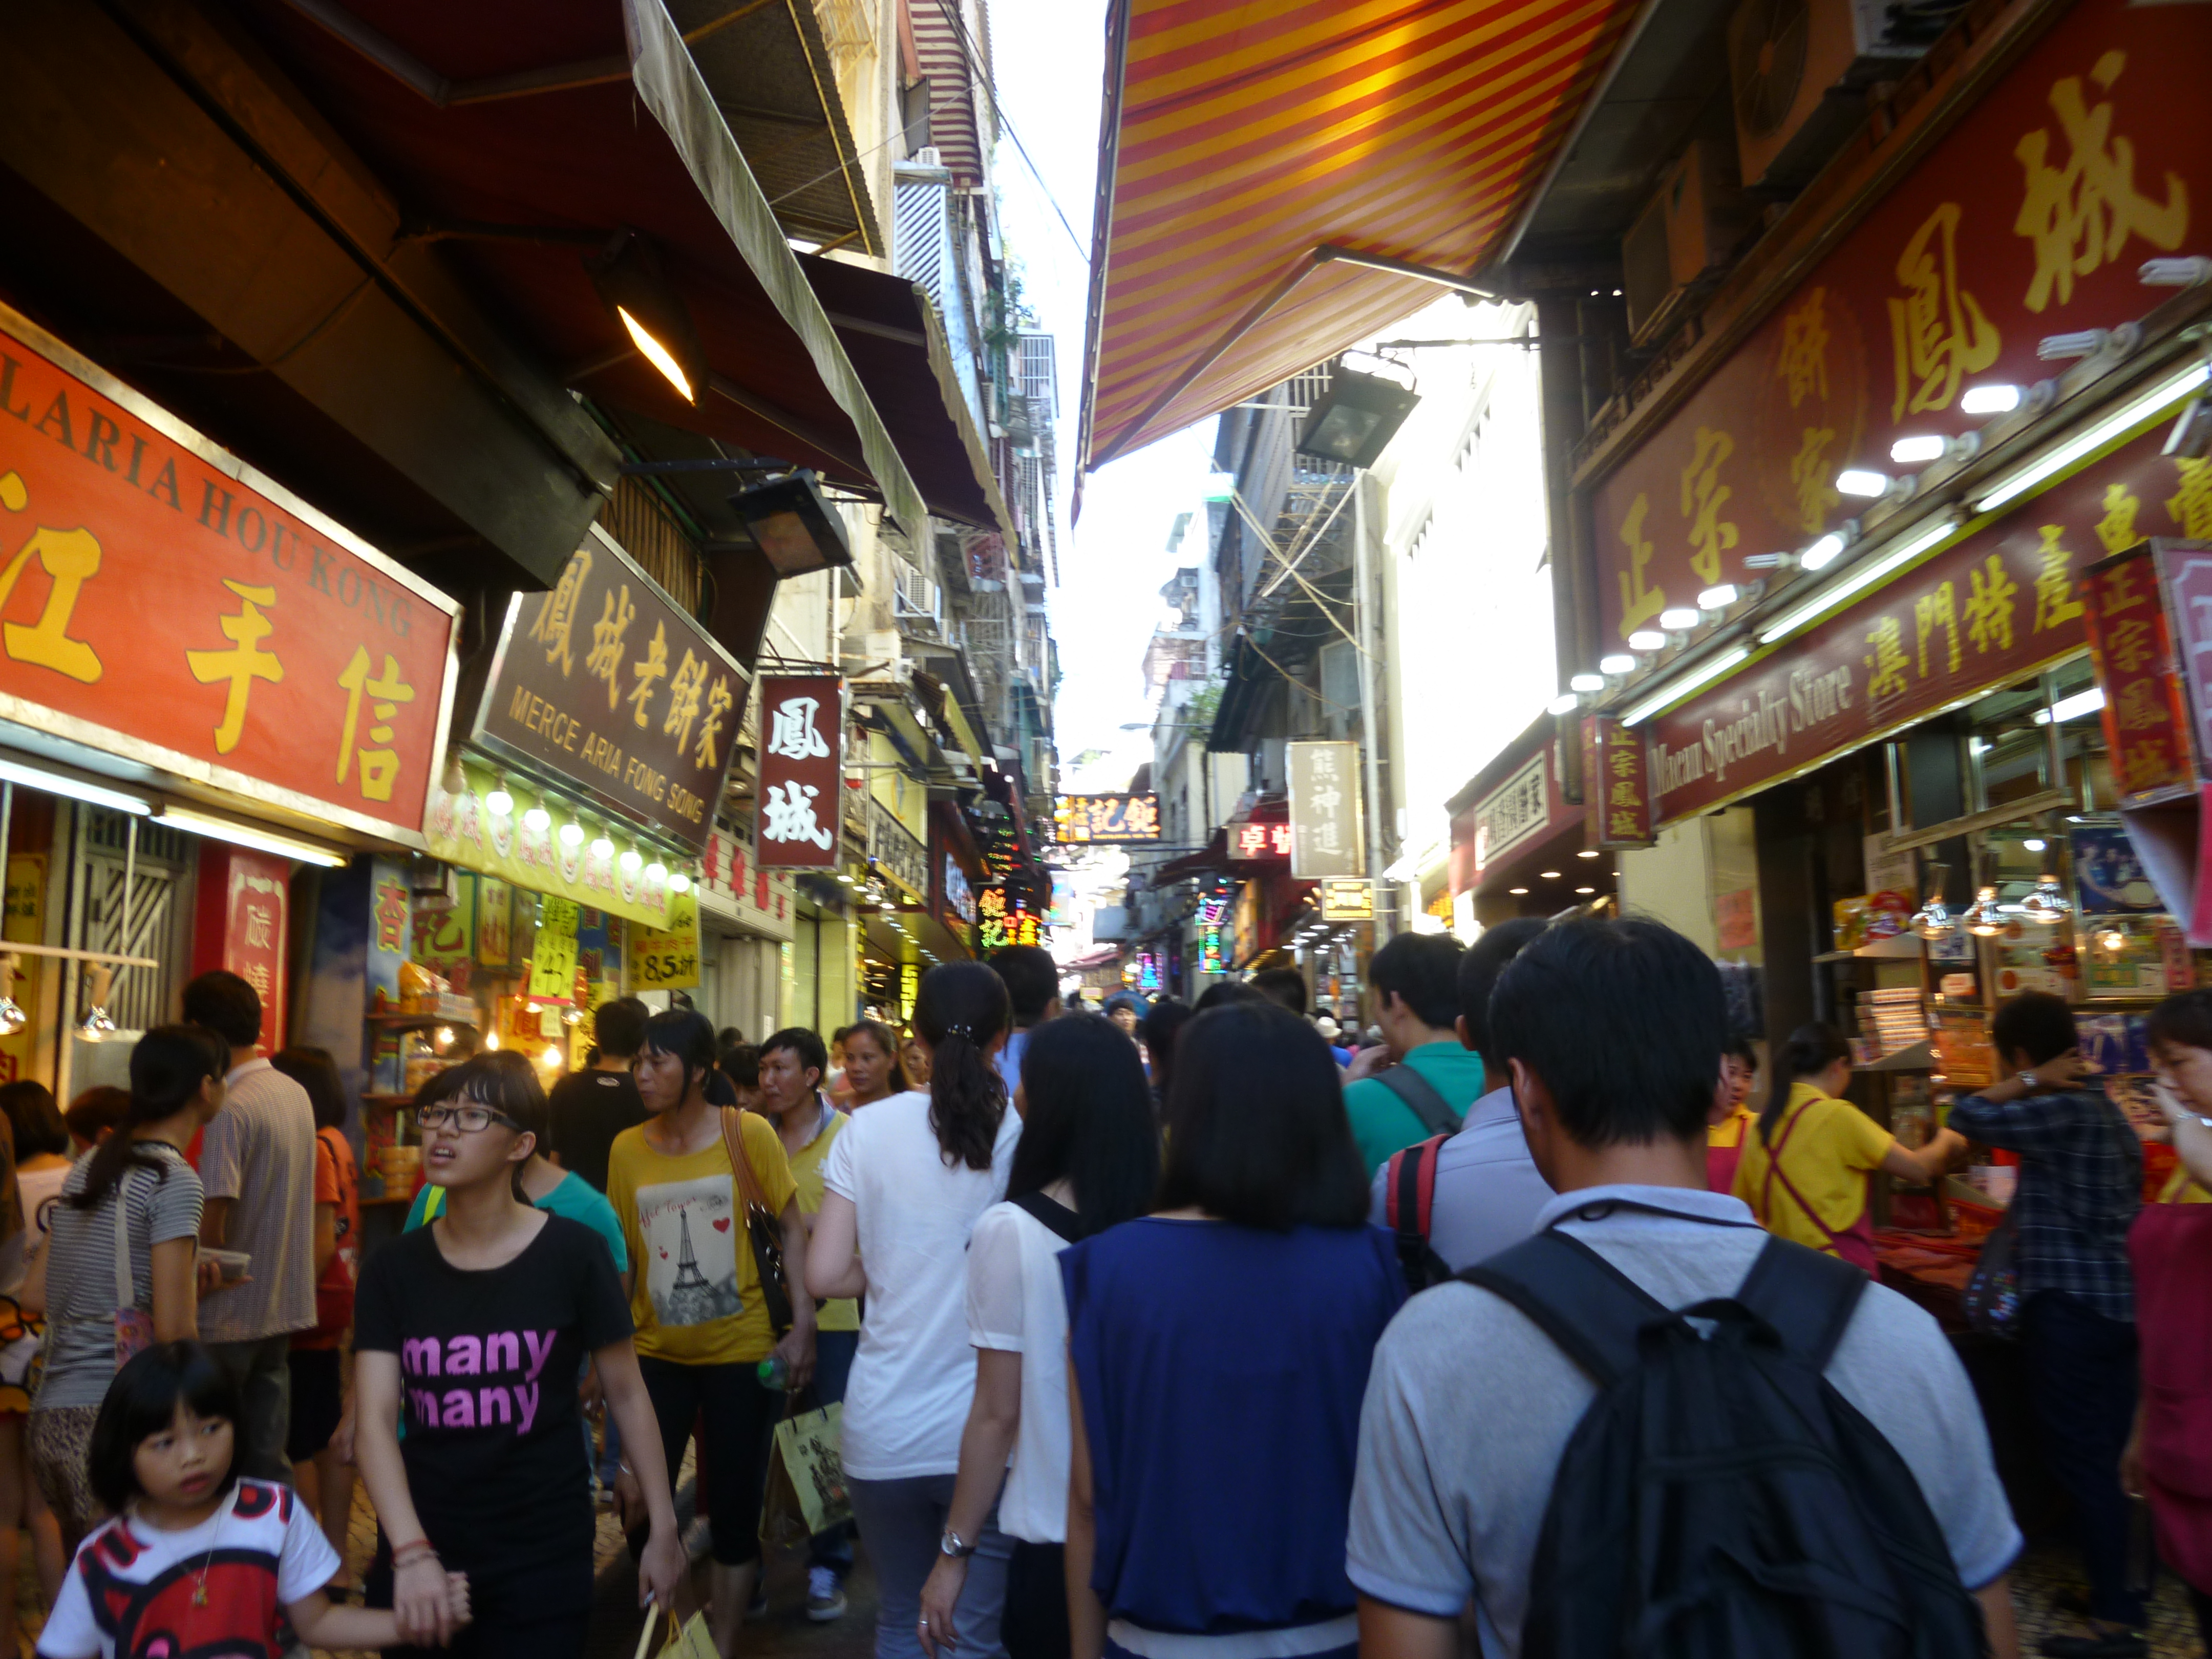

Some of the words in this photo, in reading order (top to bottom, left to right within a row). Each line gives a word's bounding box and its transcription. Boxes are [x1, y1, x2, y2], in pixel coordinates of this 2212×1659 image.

[197, 476, 301, 572] HOU
[306, 543, 411, 639] KONG
[1702, 690, 1789, 782] Specialty
[1790, 665, 1854, 732] Store
[624, 756, 667, 802] FONG
[667, 782, 706, 825] SONG
[762, 697, 833, 851] 鳳城
[402, 1329, 558, 1382] many
[408, 1380, 539, 1436] many
